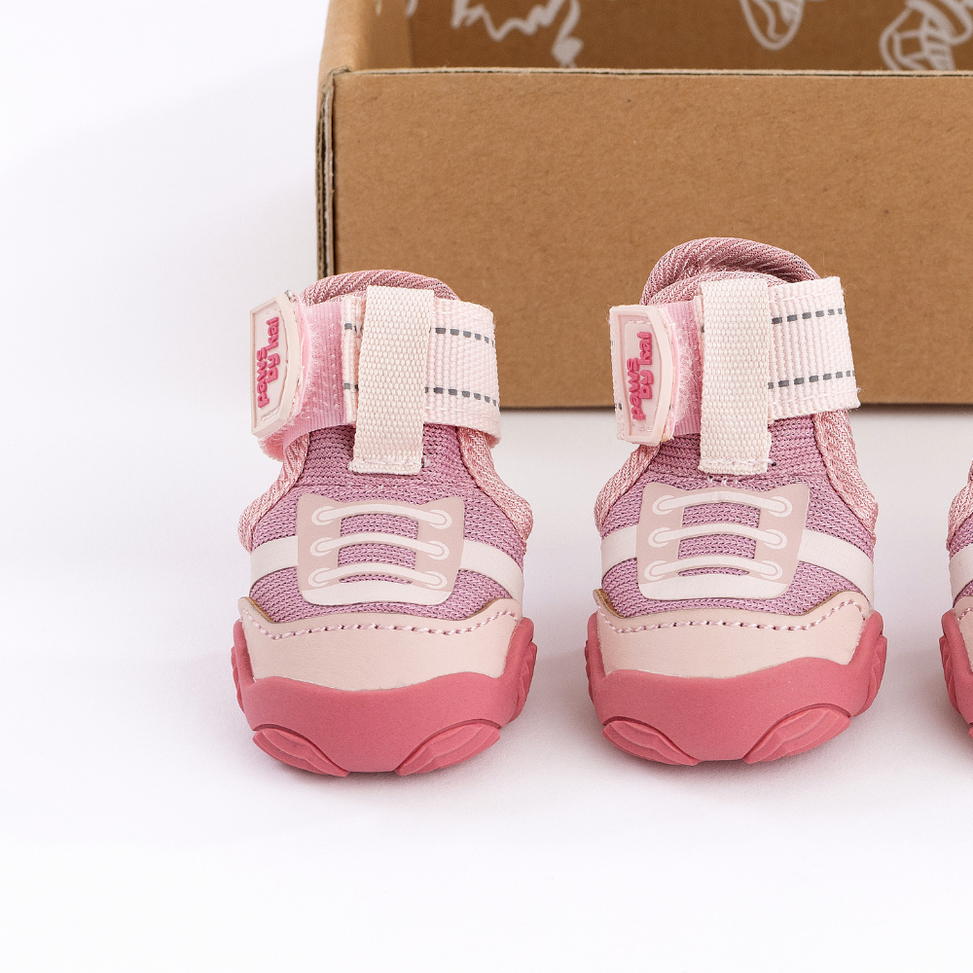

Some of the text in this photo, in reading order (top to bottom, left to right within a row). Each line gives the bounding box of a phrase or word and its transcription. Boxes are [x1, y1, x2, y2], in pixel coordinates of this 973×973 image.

[257, 346, 270, 408] paws
[266, 316, 280, 383] by kai
[637, 331, 654, 399] by kai
[627, 357, 646, 420] paws
